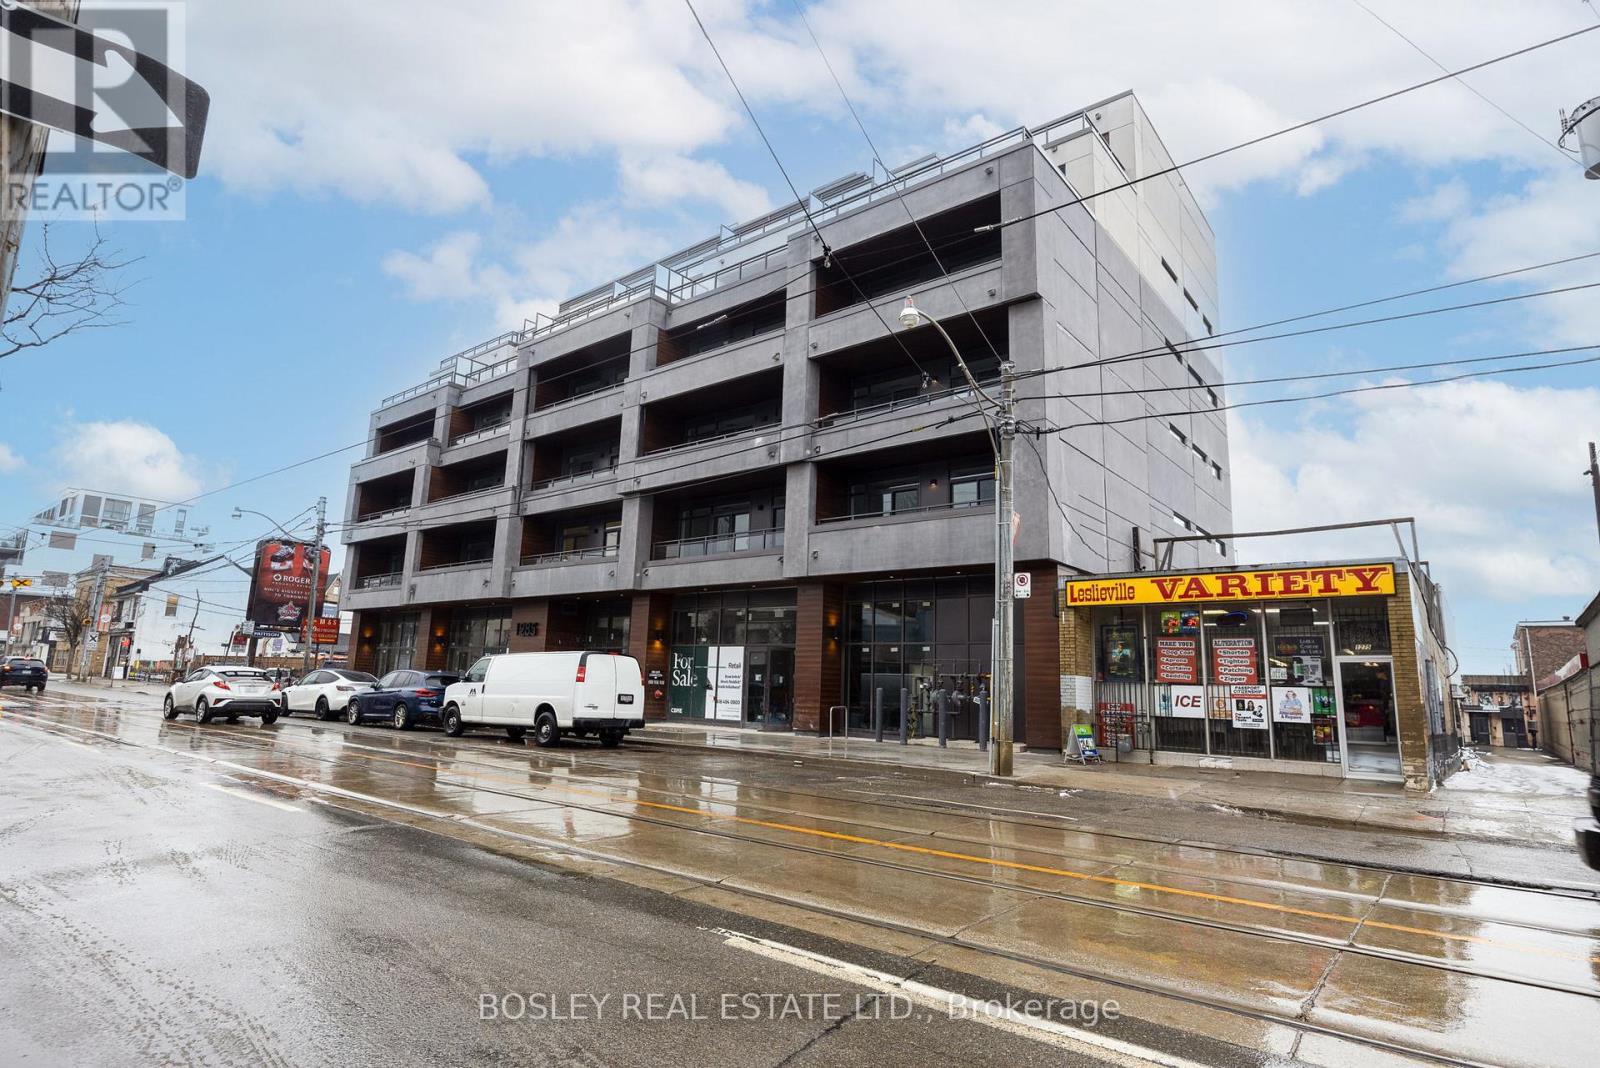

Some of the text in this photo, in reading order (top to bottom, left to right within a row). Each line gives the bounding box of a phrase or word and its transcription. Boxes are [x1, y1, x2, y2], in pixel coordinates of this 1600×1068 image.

[282, 575, 312, 584] ROGER
[1069, 566, 1389, 603] Leslieville VARIETY
[673, 652, 694, 669] For
[672, 669, 698, 687] Sale
[1174, 695, 1201, 708] ICE
